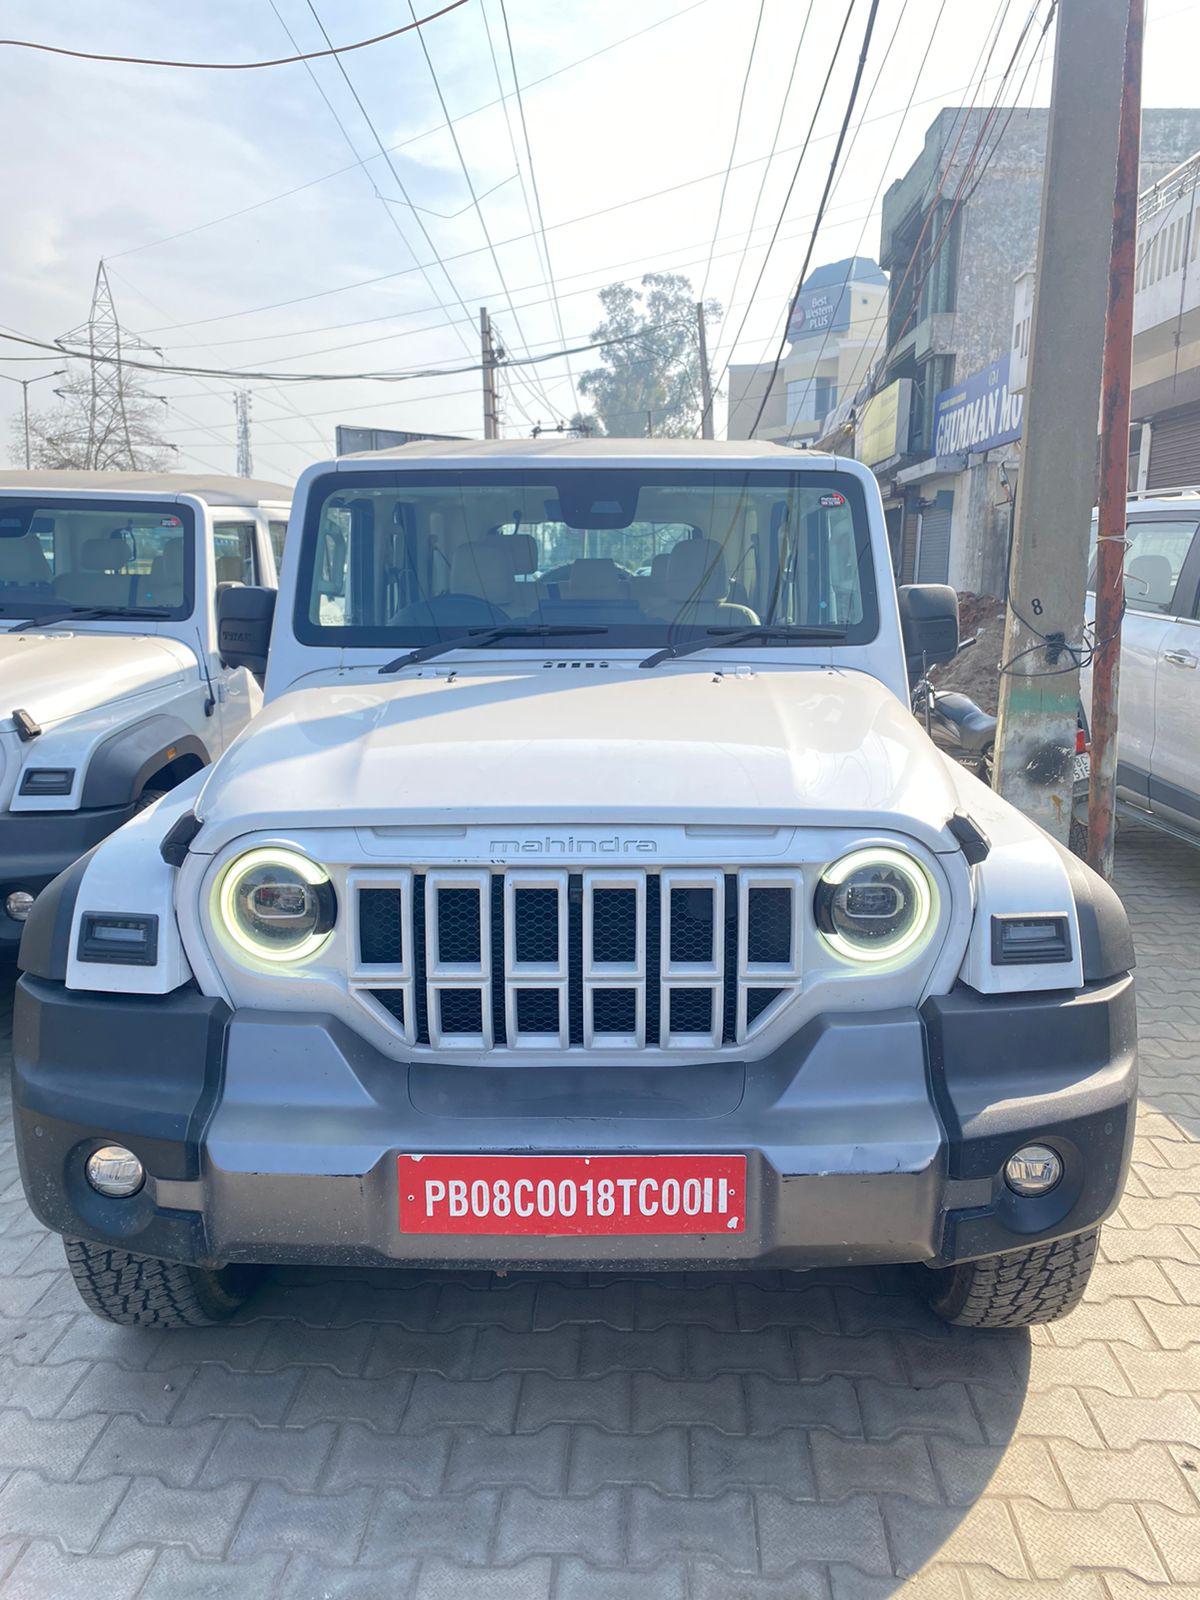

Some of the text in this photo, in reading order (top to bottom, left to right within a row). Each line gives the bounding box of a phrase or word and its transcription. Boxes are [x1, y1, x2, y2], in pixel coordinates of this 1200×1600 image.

[809, 316, 828, 328] PLUS
[936, 388, 999, 456] GHUMMAN
[1031, 598, 1043, 616] 8
[489, 836, 658, 853] mahindra
